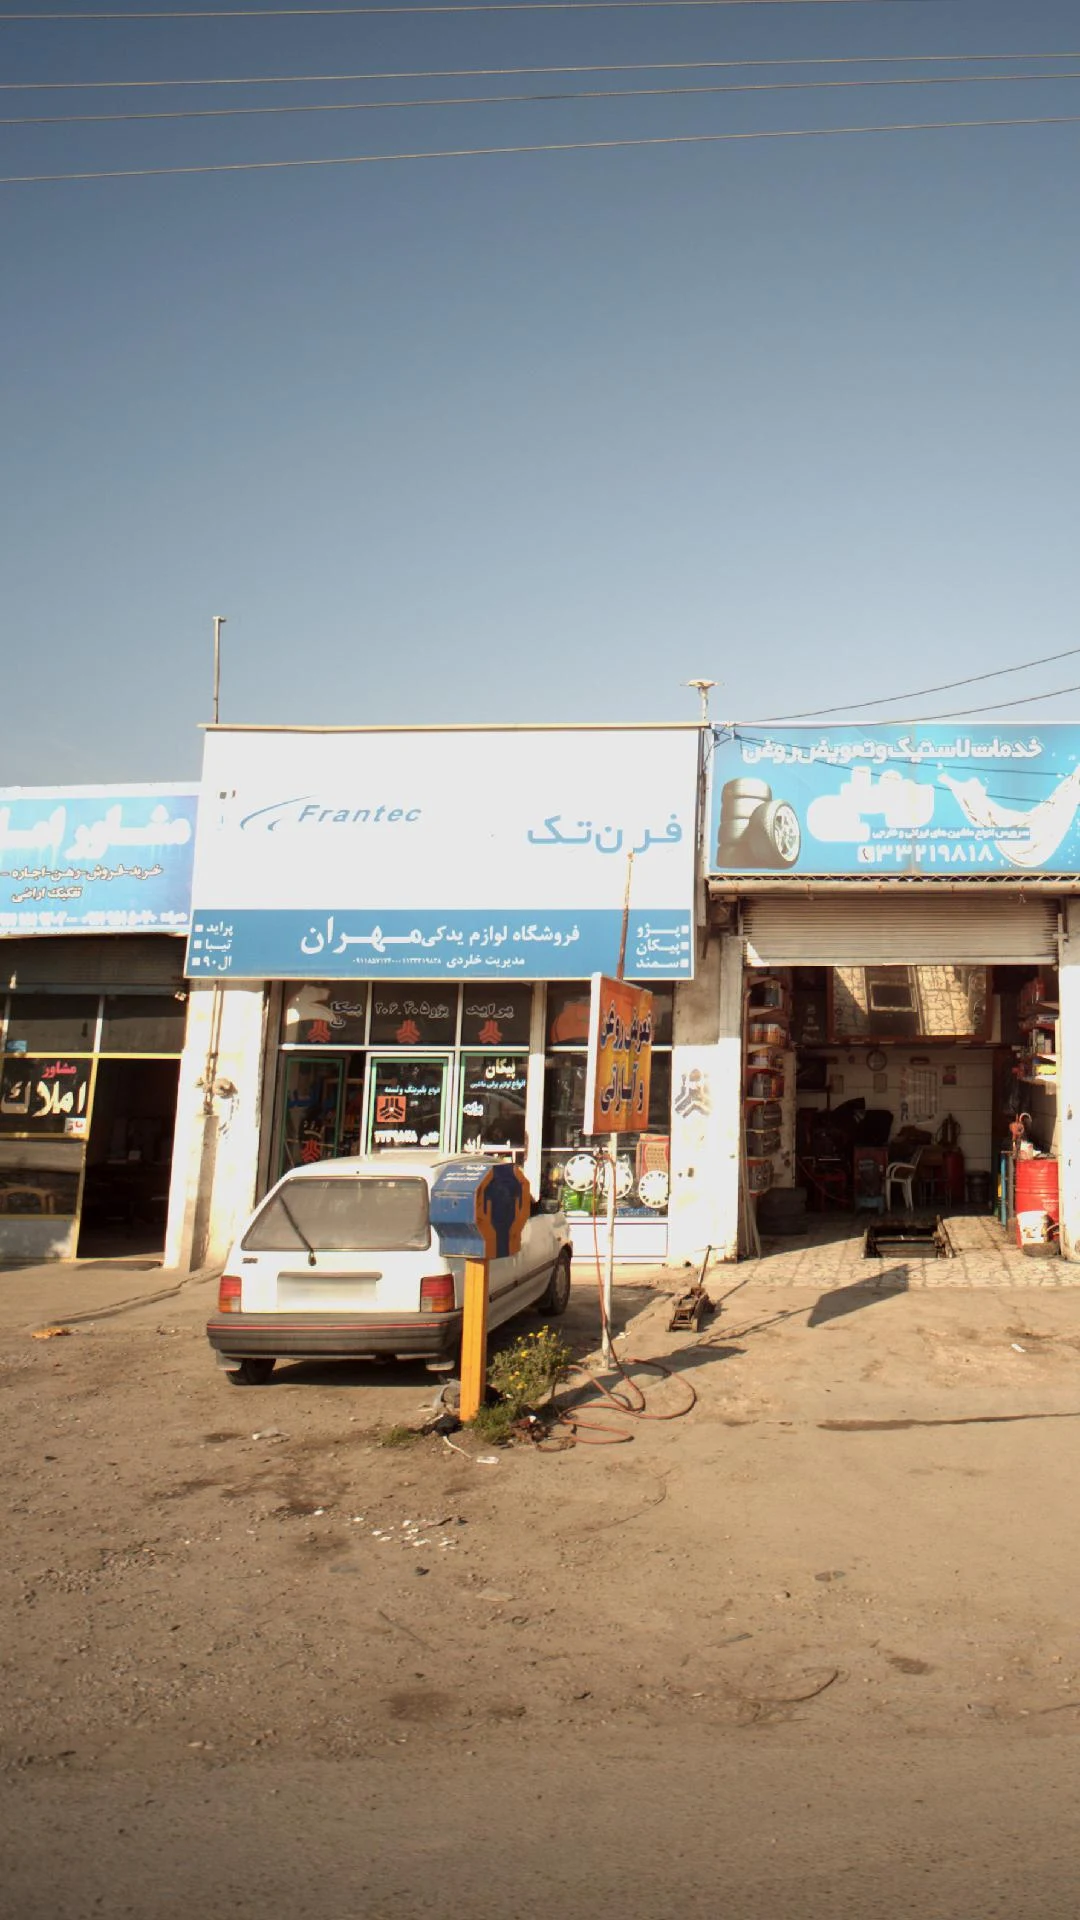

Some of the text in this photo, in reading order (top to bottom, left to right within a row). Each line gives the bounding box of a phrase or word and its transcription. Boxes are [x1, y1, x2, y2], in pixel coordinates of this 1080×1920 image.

[298, 804, 422, 823] Frantec
[206, 921, 233, 937] پراید
[300, 916, 580, 954] فروشگاه لوازم یدکی مهران
[636, 922, 680, 938] پژو
[206, 939, 232, 952] تیبا
[636, 939, 680, 955] پیکان
[485, 956, 525, 968] مدیریت
[636, 958, 679, 968] سمند
[41, 1061, 77, 1079] مشاور
